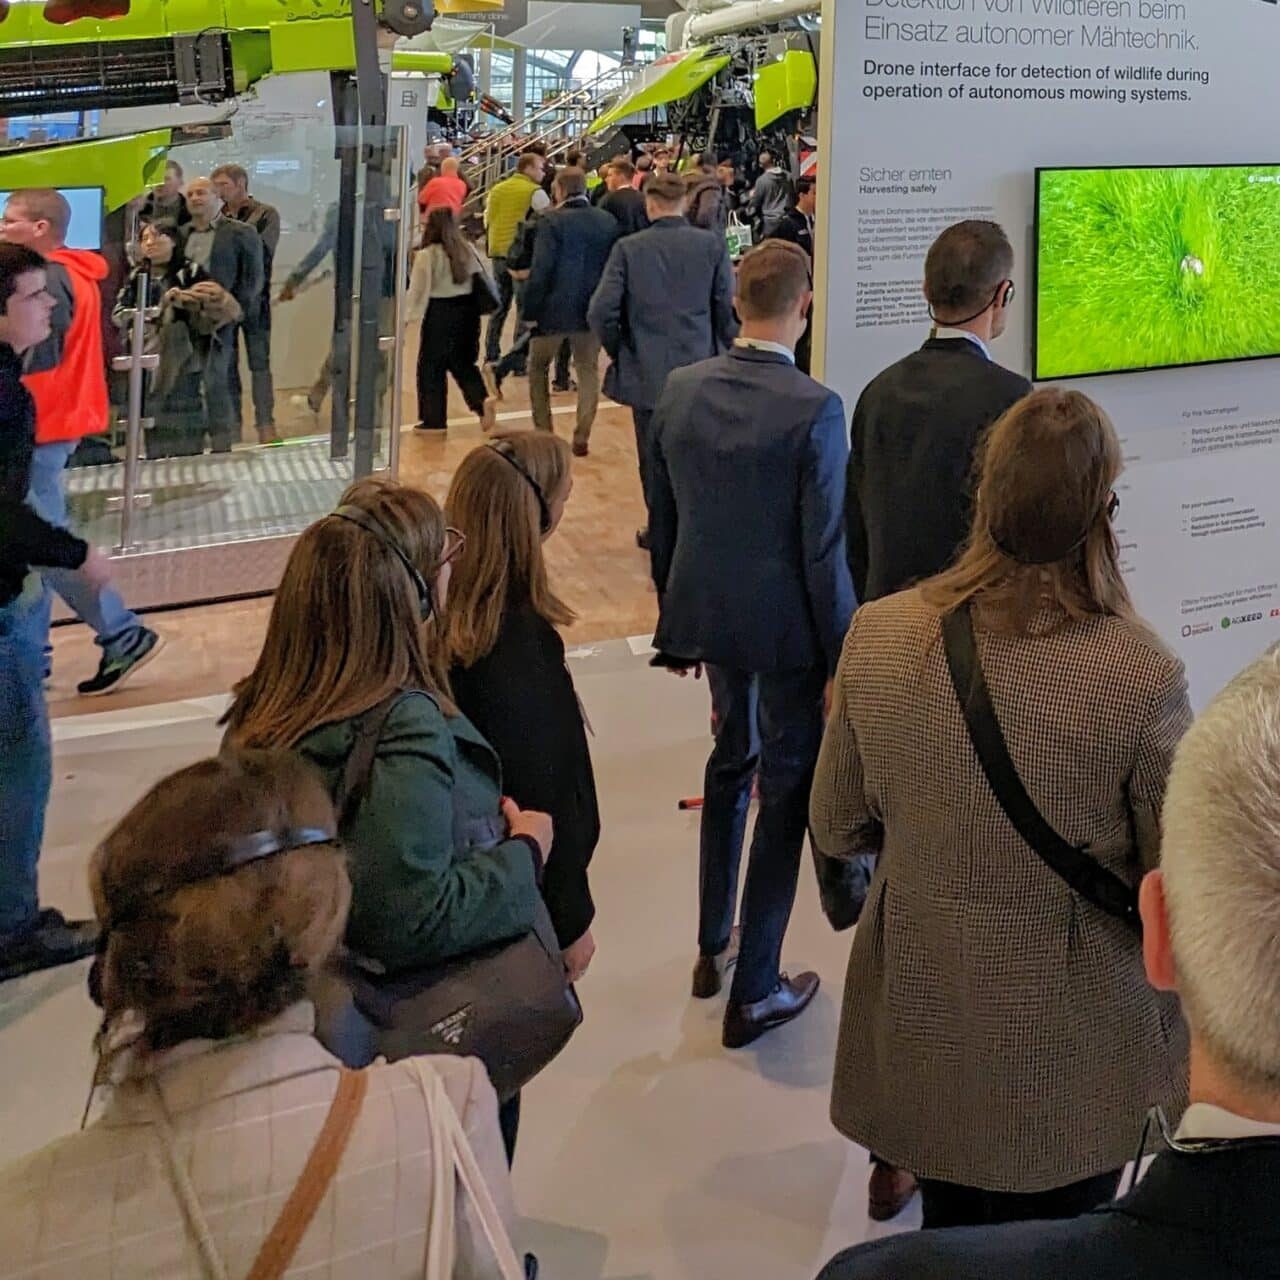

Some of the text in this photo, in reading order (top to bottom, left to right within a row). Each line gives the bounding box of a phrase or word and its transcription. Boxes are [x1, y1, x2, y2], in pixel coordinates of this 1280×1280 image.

[865, 15, 1200, 51] Einsatz autonomer Mähtechnik.
[864, 60, 1209, 85] Drone interface for detection of wildlife during
[862, 83, 1192, 104] operation of autonomous mowing systems.
[860, 167, 952, 182] Sicher ernten
[860, 184, 937, 194] Harvesting safely
